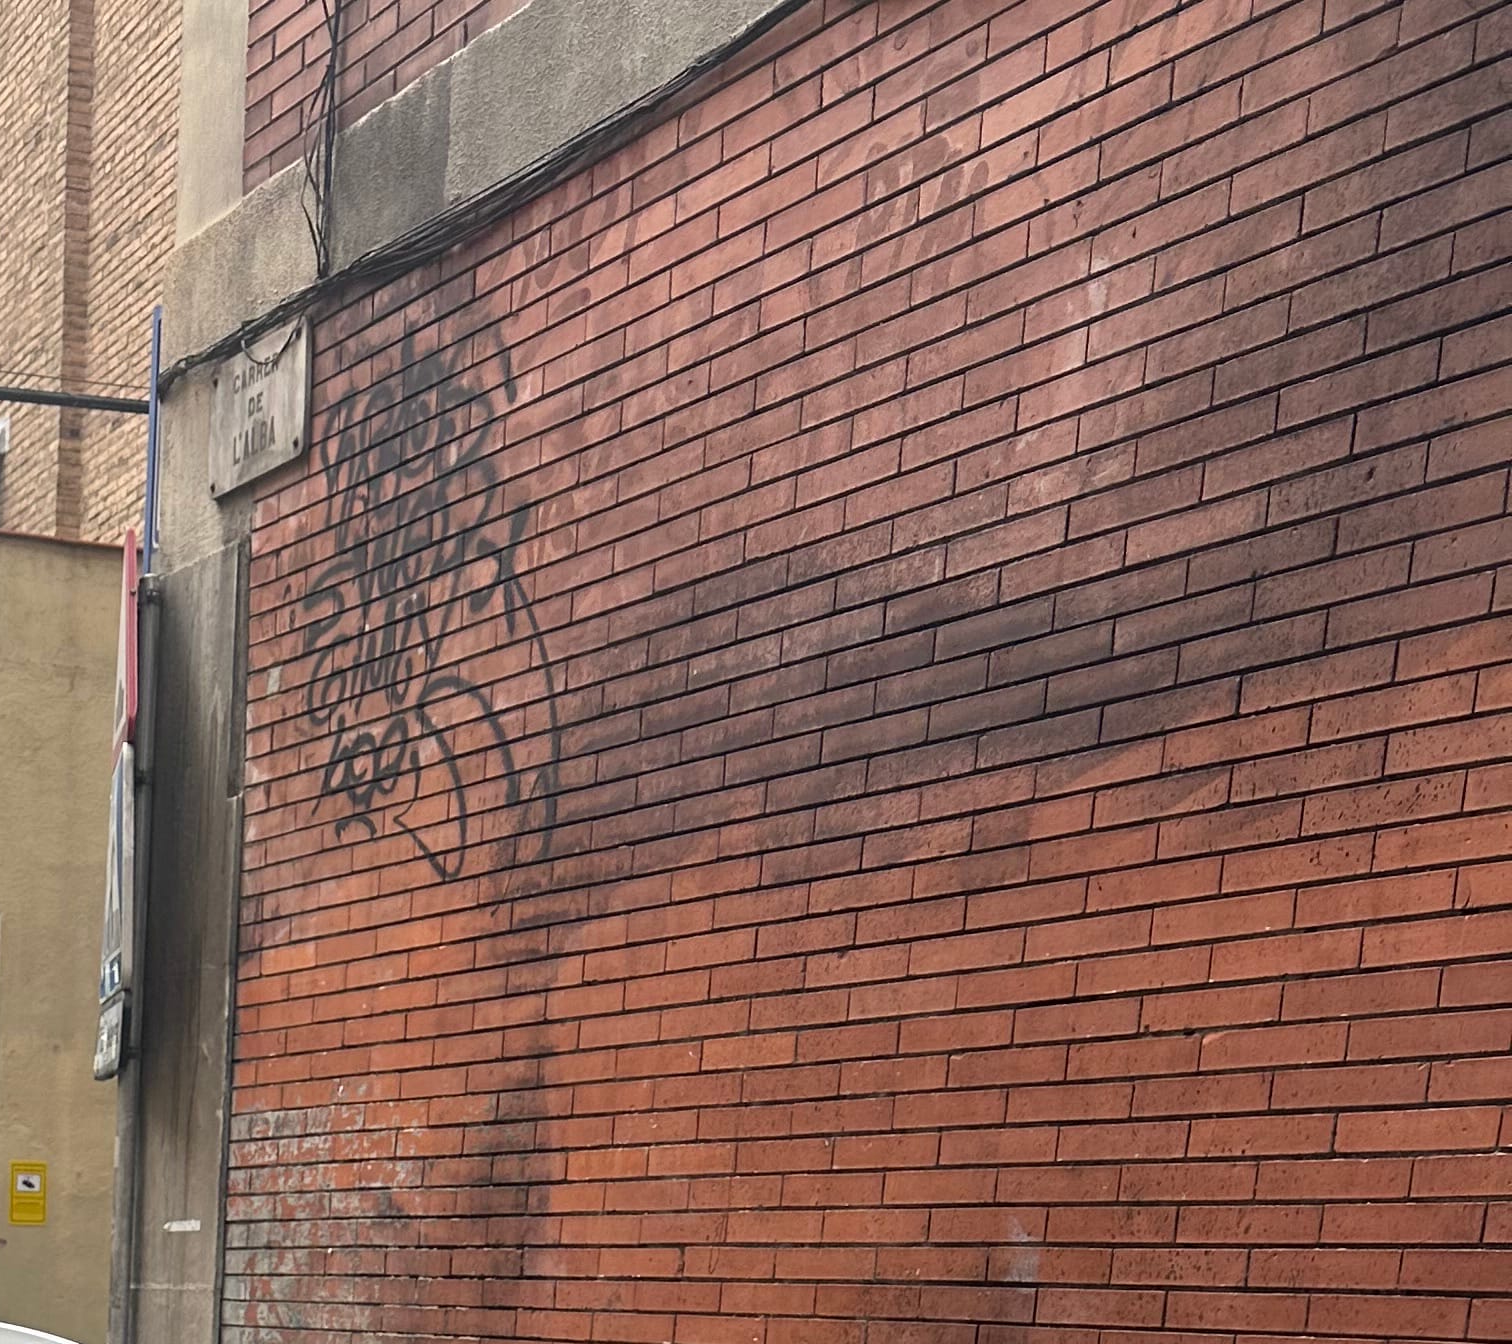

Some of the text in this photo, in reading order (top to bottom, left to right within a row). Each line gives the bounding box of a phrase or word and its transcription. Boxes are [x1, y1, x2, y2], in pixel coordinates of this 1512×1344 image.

[232, 352, 279, 395] CARRER
[248, 391, 264, 418] DE
[232, 416, 276, 466] L'ALBA
